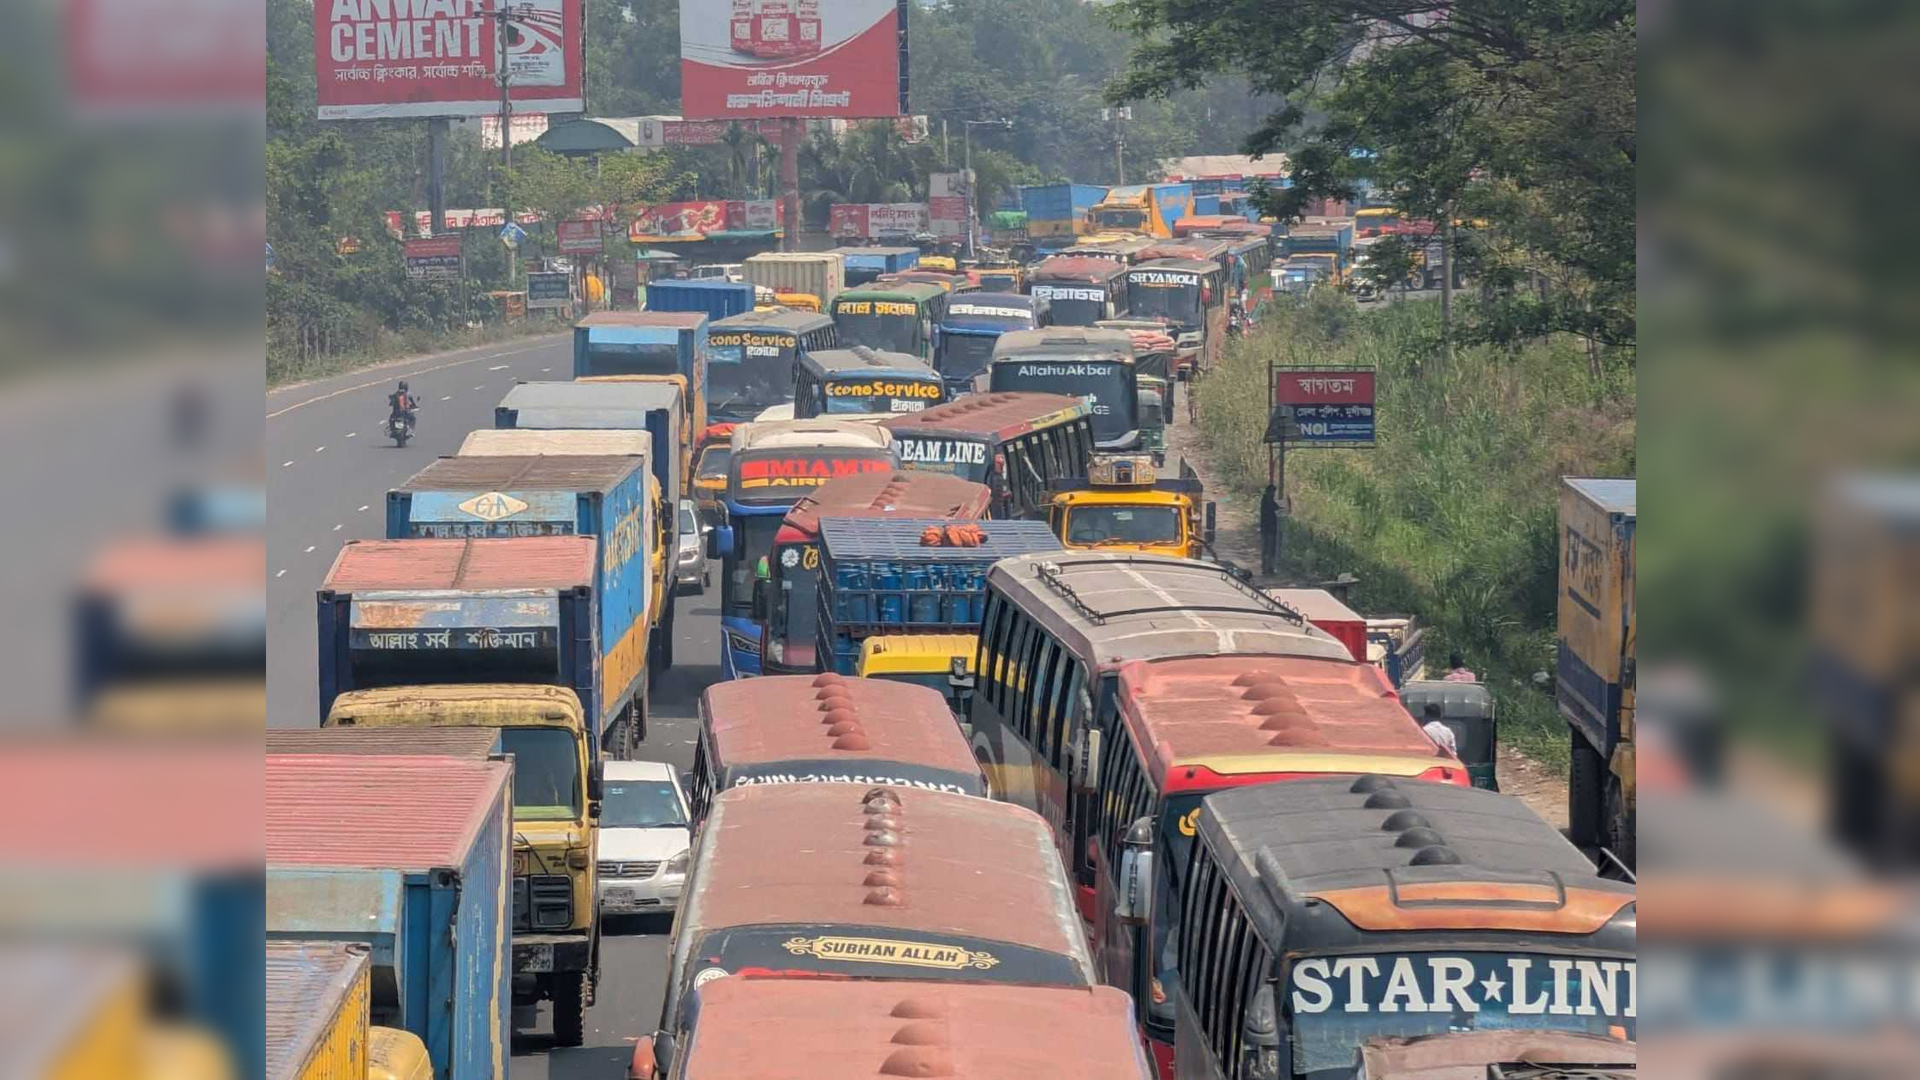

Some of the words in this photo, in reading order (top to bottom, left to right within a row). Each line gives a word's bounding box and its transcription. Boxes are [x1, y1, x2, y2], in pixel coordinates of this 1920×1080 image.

[331, 18, 484, 62] CEMENT
[1129, 272, 1198, 286] SHYAMOLI
[1296, 376, 1355, 395] স্বাগতম
[944, 441, 986, 464] LINE
[423, 629, 451, 649] সর্ব
[821, 941, 897, 957] SUBHAN
[901, 946, 958, 962] ALLAH
[1292, 957, 1480, 1013] STAR
